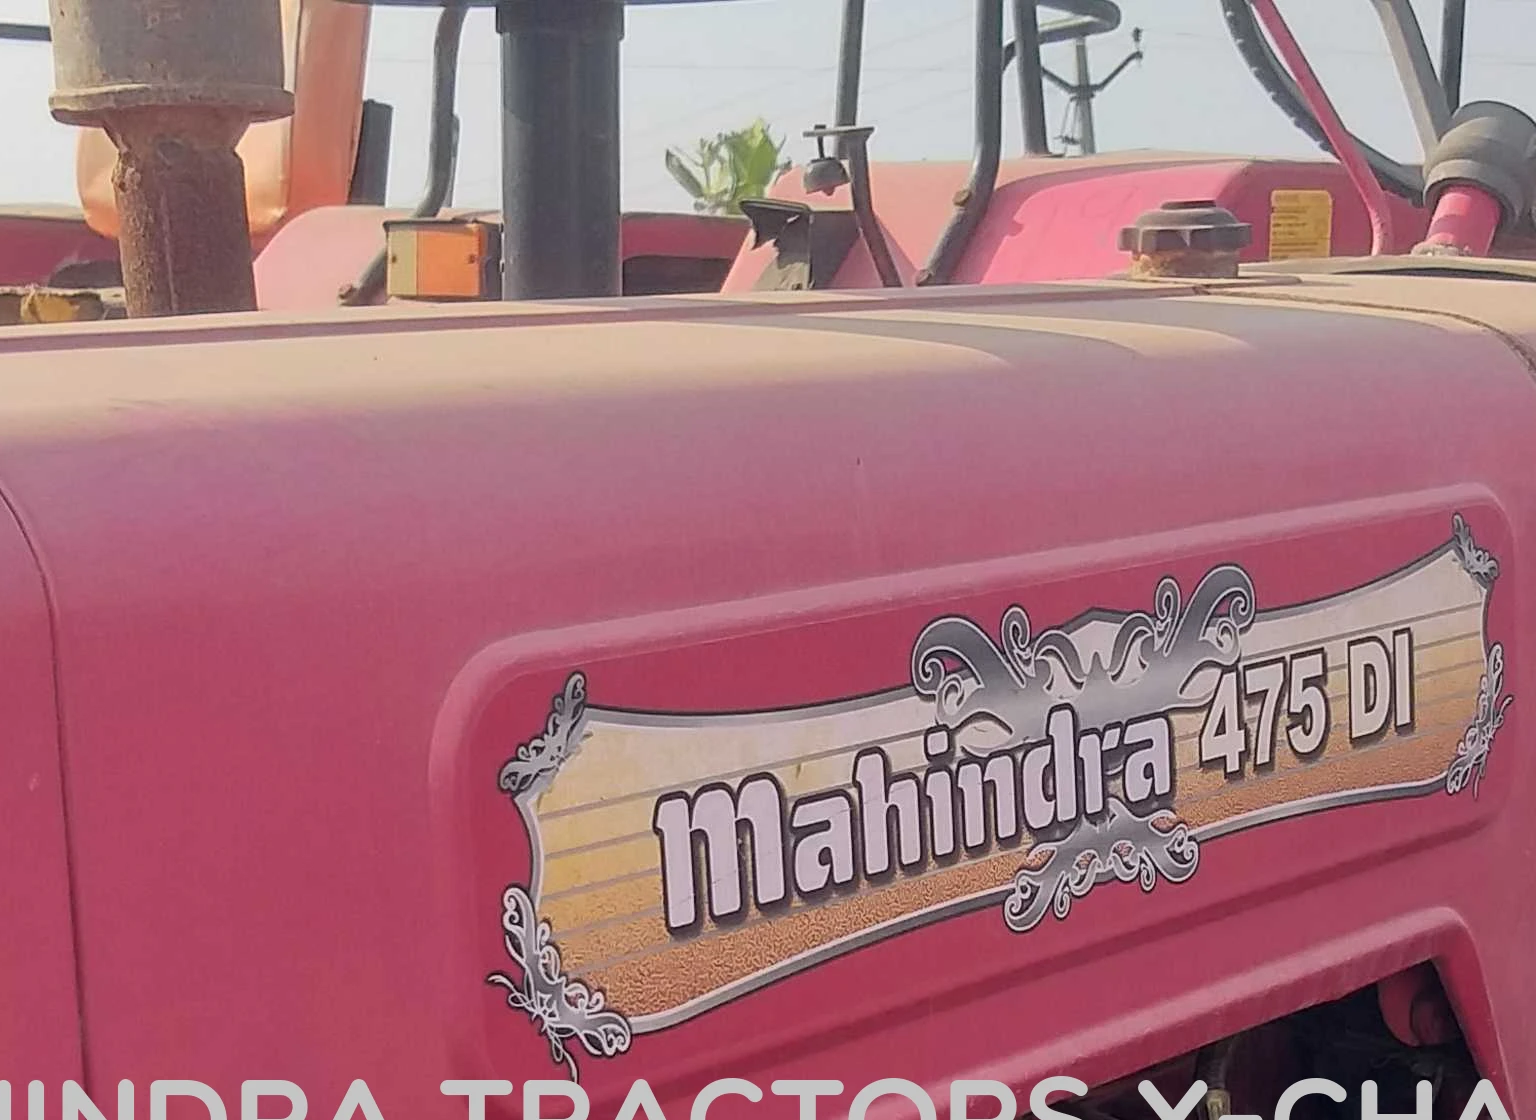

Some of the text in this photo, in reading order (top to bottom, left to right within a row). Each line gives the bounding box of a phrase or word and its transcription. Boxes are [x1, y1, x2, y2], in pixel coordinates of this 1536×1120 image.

[653, 627, 1413, 932] Mahindra 475 DI
